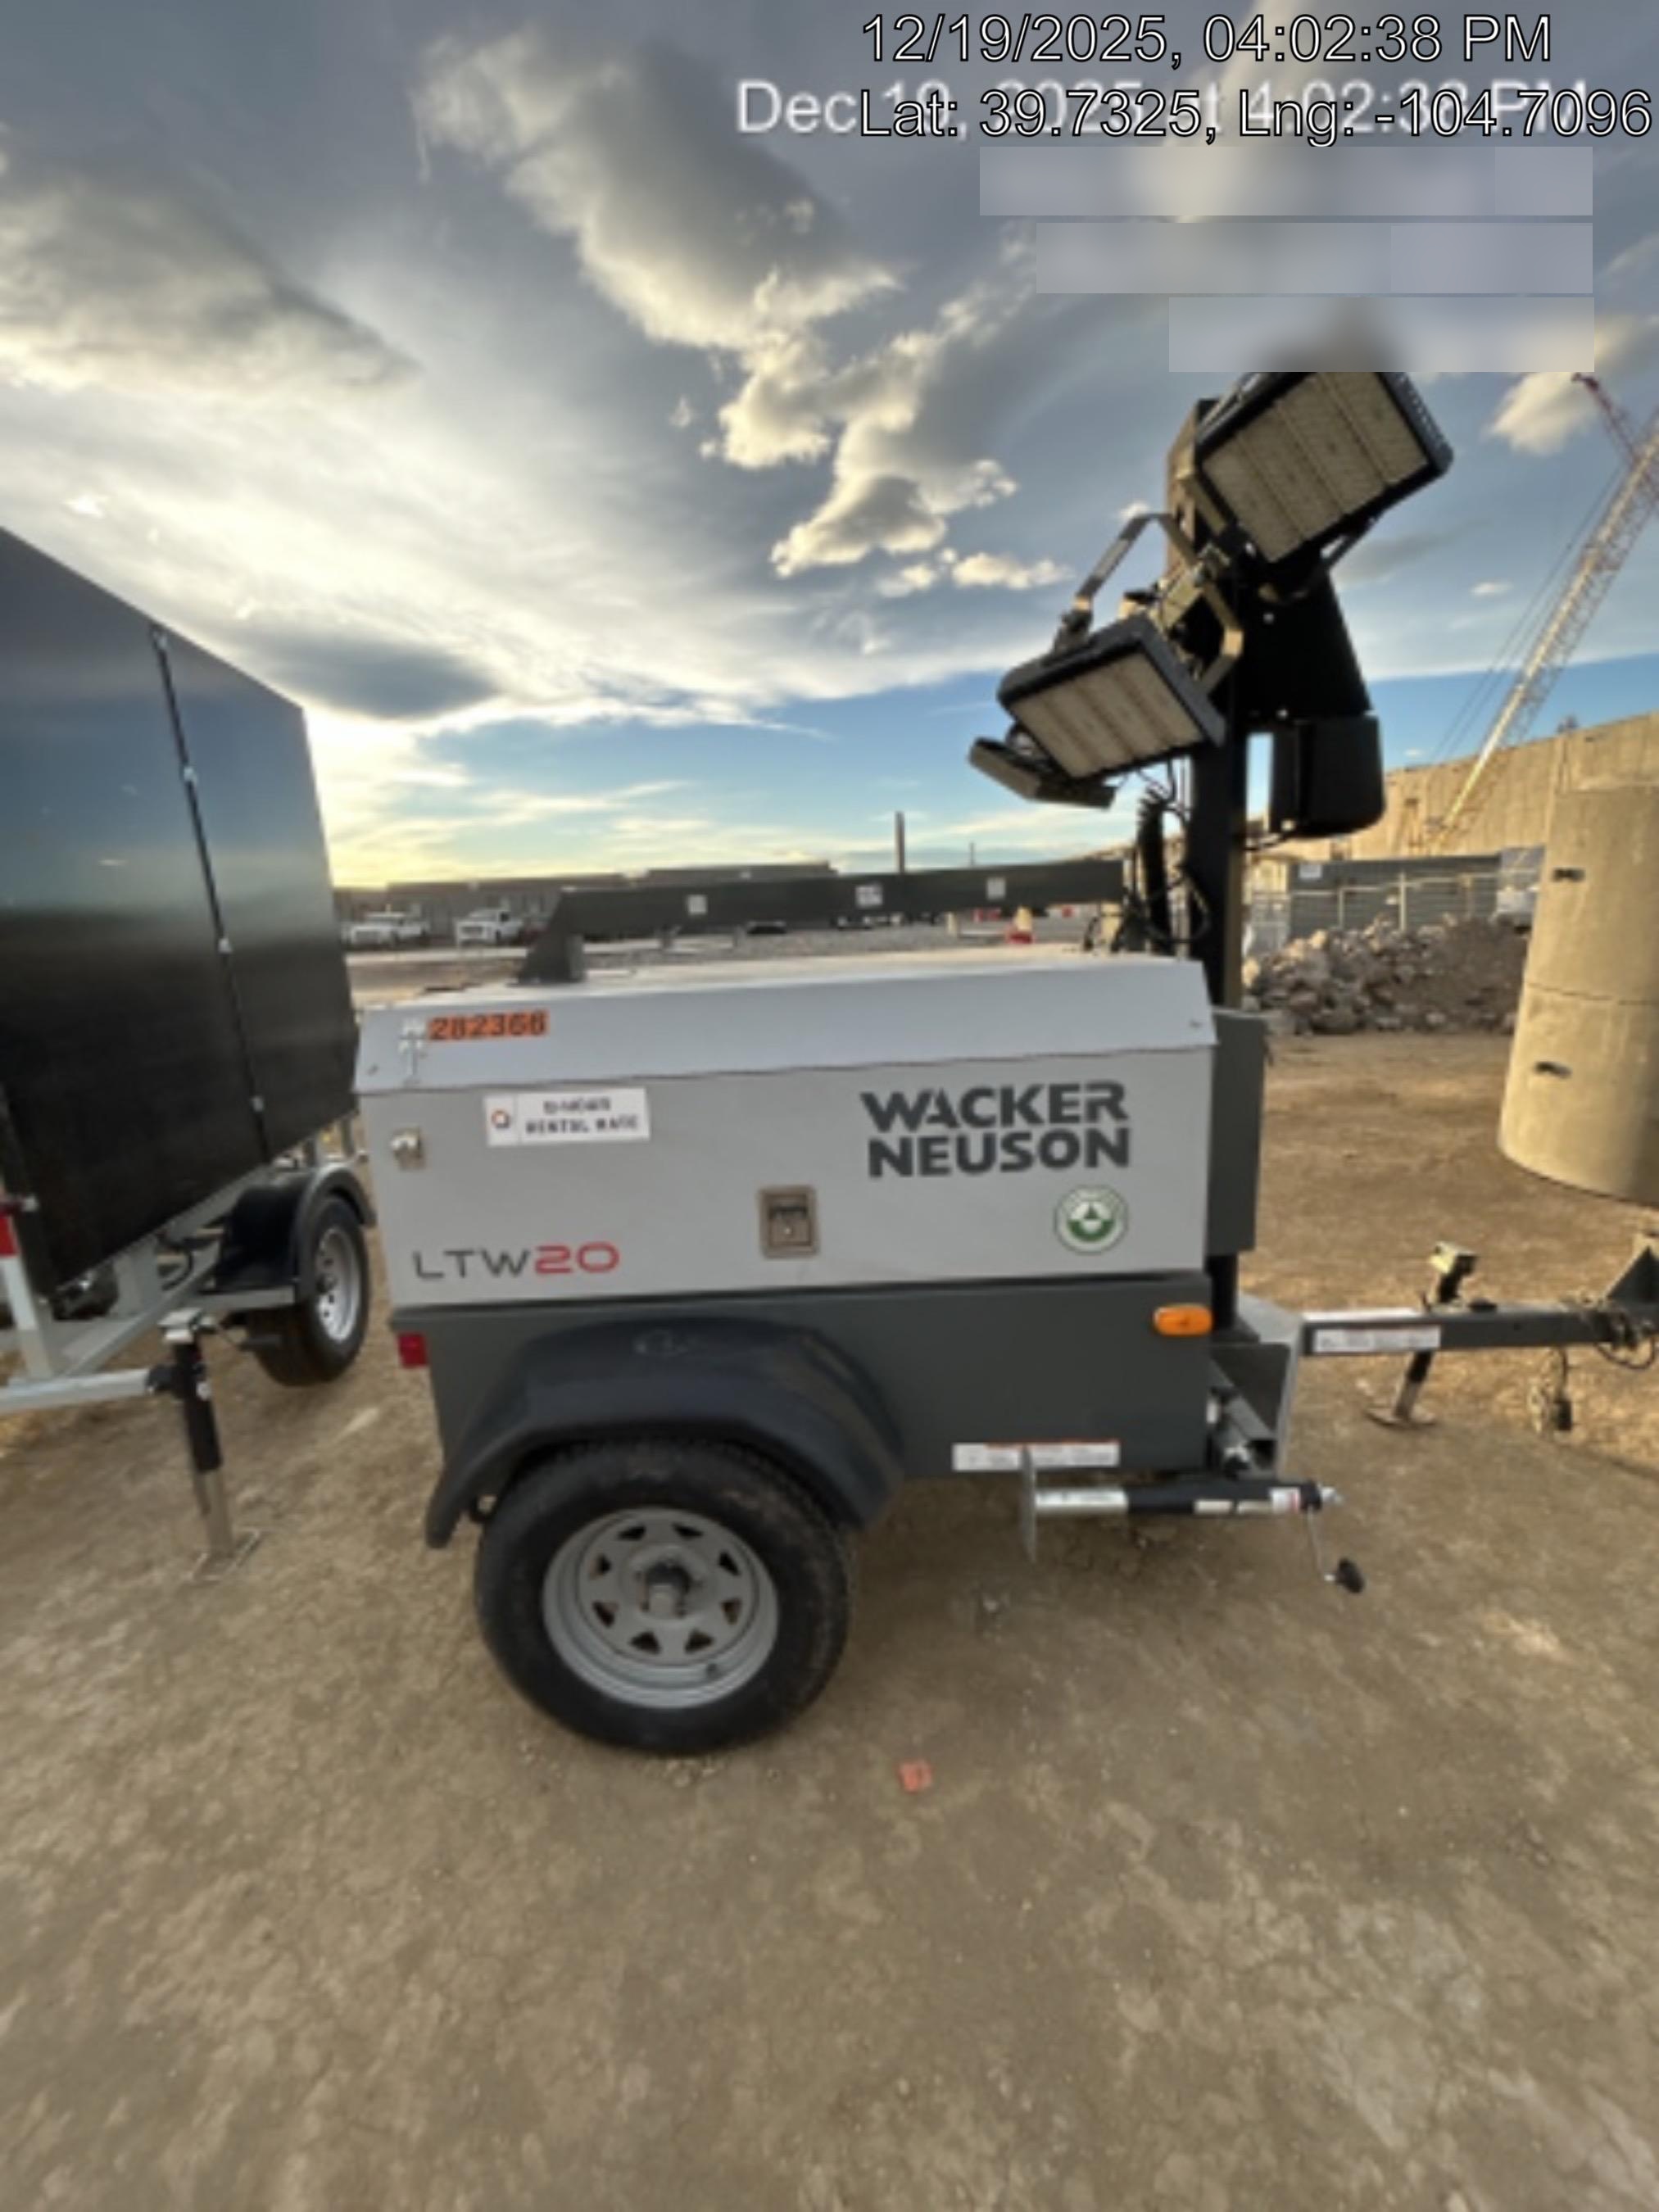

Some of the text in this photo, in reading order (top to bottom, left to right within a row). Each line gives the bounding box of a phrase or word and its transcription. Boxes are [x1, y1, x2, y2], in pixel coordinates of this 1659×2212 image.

[859, 1080, 1130, 1132] WACKER
[868, 1127, 1131, 1178] NEUSON
[413, 1241, 621, 1279] LTW20
